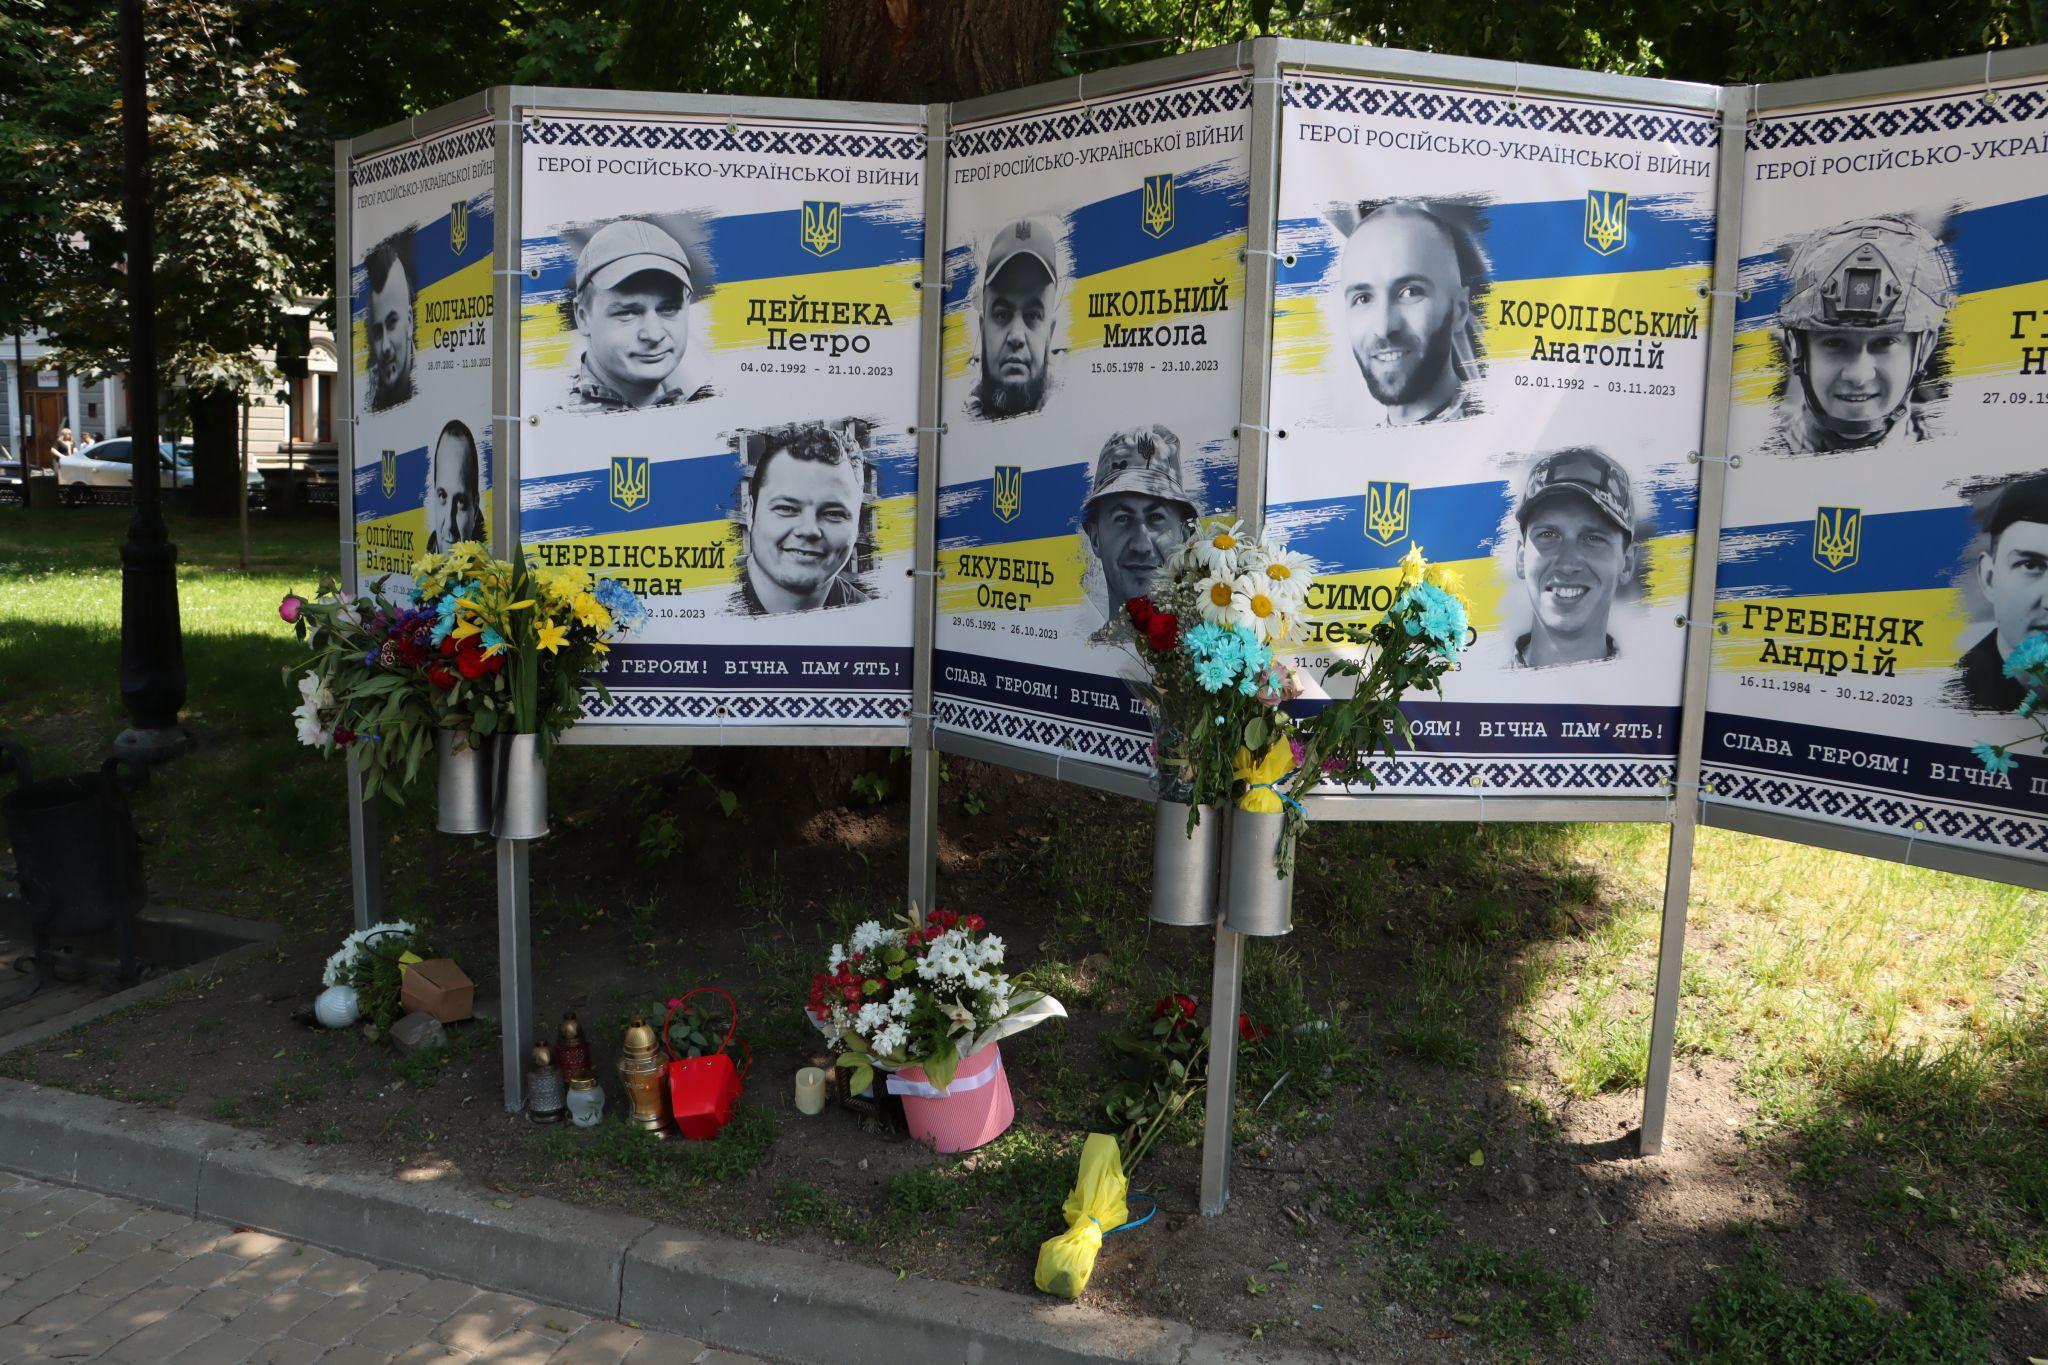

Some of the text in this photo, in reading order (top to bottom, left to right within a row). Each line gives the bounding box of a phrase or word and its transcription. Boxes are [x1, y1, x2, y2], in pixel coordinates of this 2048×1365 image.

[954, 124, 1244, 184] ГЕРОЇ РОСІЙСЬКО-УКРАЇНСЬКОЇ ВІЙНИ
[1298, 124, 1712, 178] ГЕРОЇ РОСІЙСЬКО-УКРАЇНСЬКОЇ ВІЙНИ
[537, 156, 920, 187] ГЕРОЇ РОСІЙСЬКО-УКРАЇНСЬКОЇ ВІЙНИ
[1755, 155, 1817, 180] ГЕРОЇ
[357, 189, 376, 209] ГЕРОЇ
[376, 163, 471, 202] РОСІЙСЬКО-УКРАЇНСЬКОЇ
[425, 295, 494, 323] МОЛЧАНОВ
[746, 294, 894, 326] ДЕЙНЕКА
[1088, 277, 1229, 318] ШКОЛЬНИЙ
[1499, 300, 1699, 339] КОРОЛІВСЬКИЙ
[2010, 310, 2048, 339] Г
[433, 321, 486, 352] Сергій
[767, 328, 871, 357] Петро
[1103, 324, 1208, 348] Микола
[1531, 335, 1665, 369] Анатолій
[740, 362, 807, 374] 04.02.1992
[828, 365, 894, 376] 21.10.2023
[1091, 362, 1144, 374] 15.05.1978
[1161, 360, 1219, 372] 23.10.2023
[1514, 375, 1585, 390] 02.01.1992
[1608, 382, 1676, 396] 03.11.2023
[366, 523, 414, 551] ОЛІЙНИК
[366, 549, 415, 575] Віталій
[538, 541, 726, 569] ЧЕРВІНСЬКИЙ
[958, 554, 1055, 588] ЯКУБЕЦЬ
[977, 584, 1031, 611] Олег
[647, 608, 706, 619] 2.10.2023
[952, 616, 996, 632] 29.05.1992
[1010, 624, 1058, 640] 26.10.2023
[1742, 604, 1924, 647] ГРЕБЕНЯК
[621, 659, 708, 675] ГЕРОЯМ!
[724, 660, 790, 675] ВІЧНА
[1759, 638, 1897, 677] Андрій
[945, 666, 988, 687] СЛАВА
[996, 675, 1058, 699] ГЕРОЯМ!
[1070, 688, 1120, 711] ВІЧНА
[1740, 675, 1811, 694] 16.11.1984
[1836, 687, 1913, 707] 30.12.2023
[1479, 720, 1547, 738] ВІЧНА
[1723, 732, 1793, 757] СЛАВА
[1807, 744, 1909, 775] ГЕРОЯМ!
[1930, 763, 2012, 790] ВІЧНА
